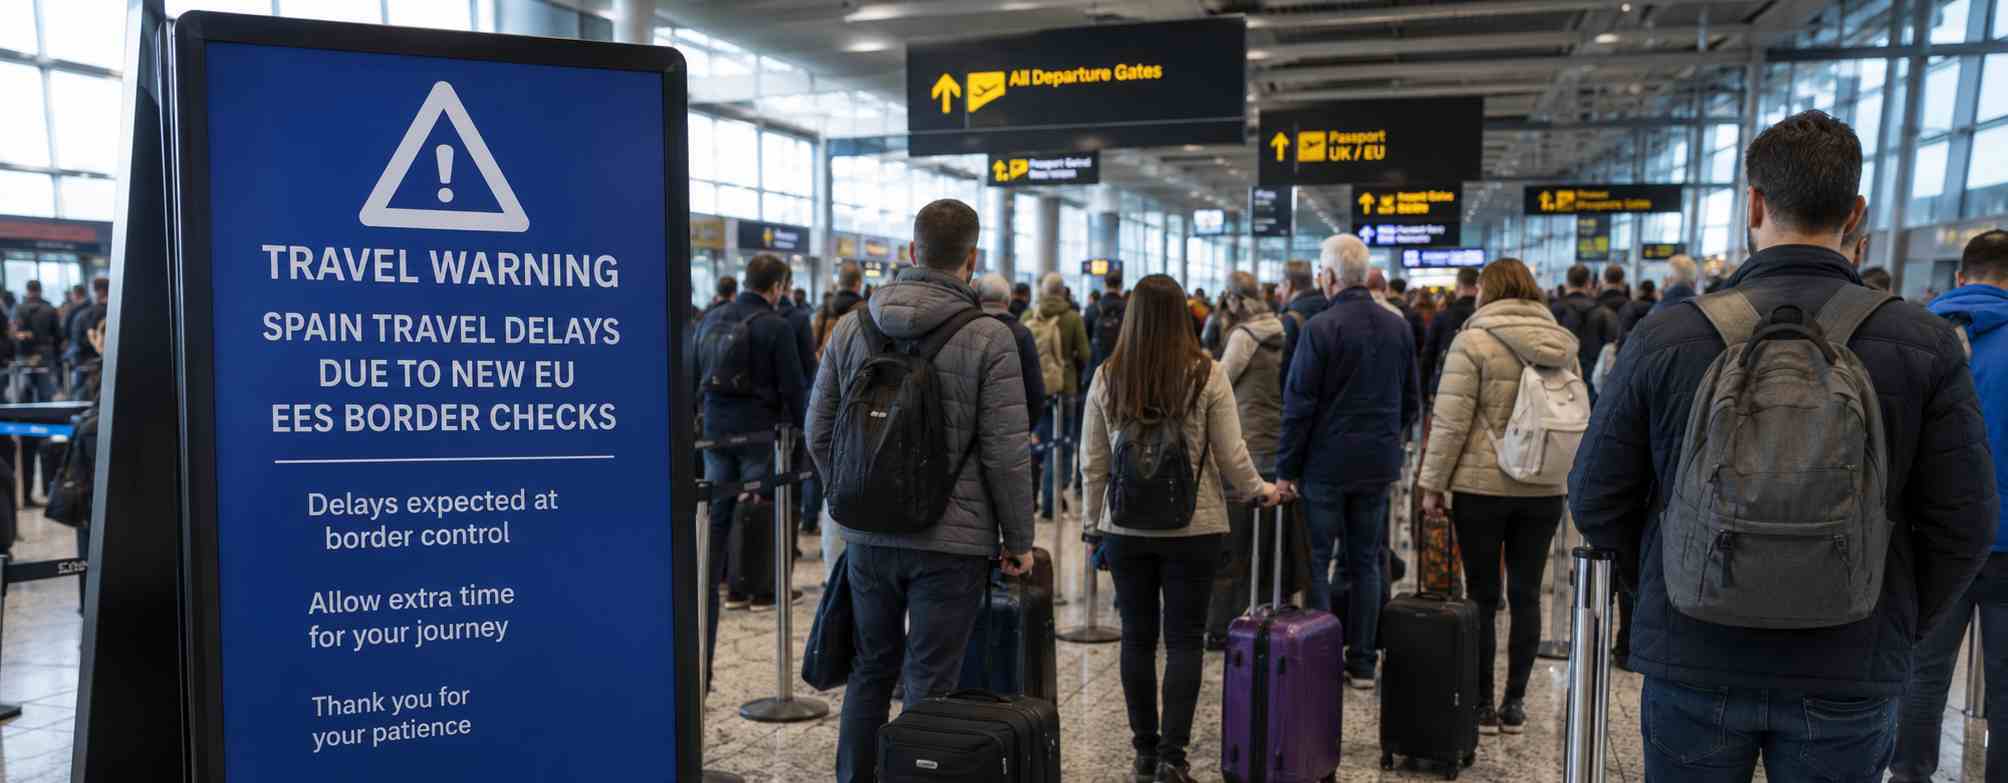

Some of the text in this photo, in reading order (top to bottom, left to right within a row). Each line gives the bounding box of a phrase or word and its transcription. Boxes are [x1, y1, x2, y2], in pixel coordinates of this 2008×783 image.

[1008, 63, 1163, 88] All Departure Gates
[1328, 129, 1386, 145] Passport
[1328, 144, 1386, 161] UK / EU
[261, 244, 619, 288] TRAVEL WARNING
[263, 311, 620, 345] SPAIN TRAVEL DELAYS
[319, 358, 574, 388] DUE TO NEW EU
[272, 403, 617, 433] EES BORDER CHECKS
[308, 488, 559, 521] Delays expected at
[325, 521, 510, 550] border control
[308, 583, 515, 615] Allow extra time
[308, 619, 509, 652] for your journey
[311, 686, 470, 717] Thank you for
[312, 718, 471, 753] your patience
